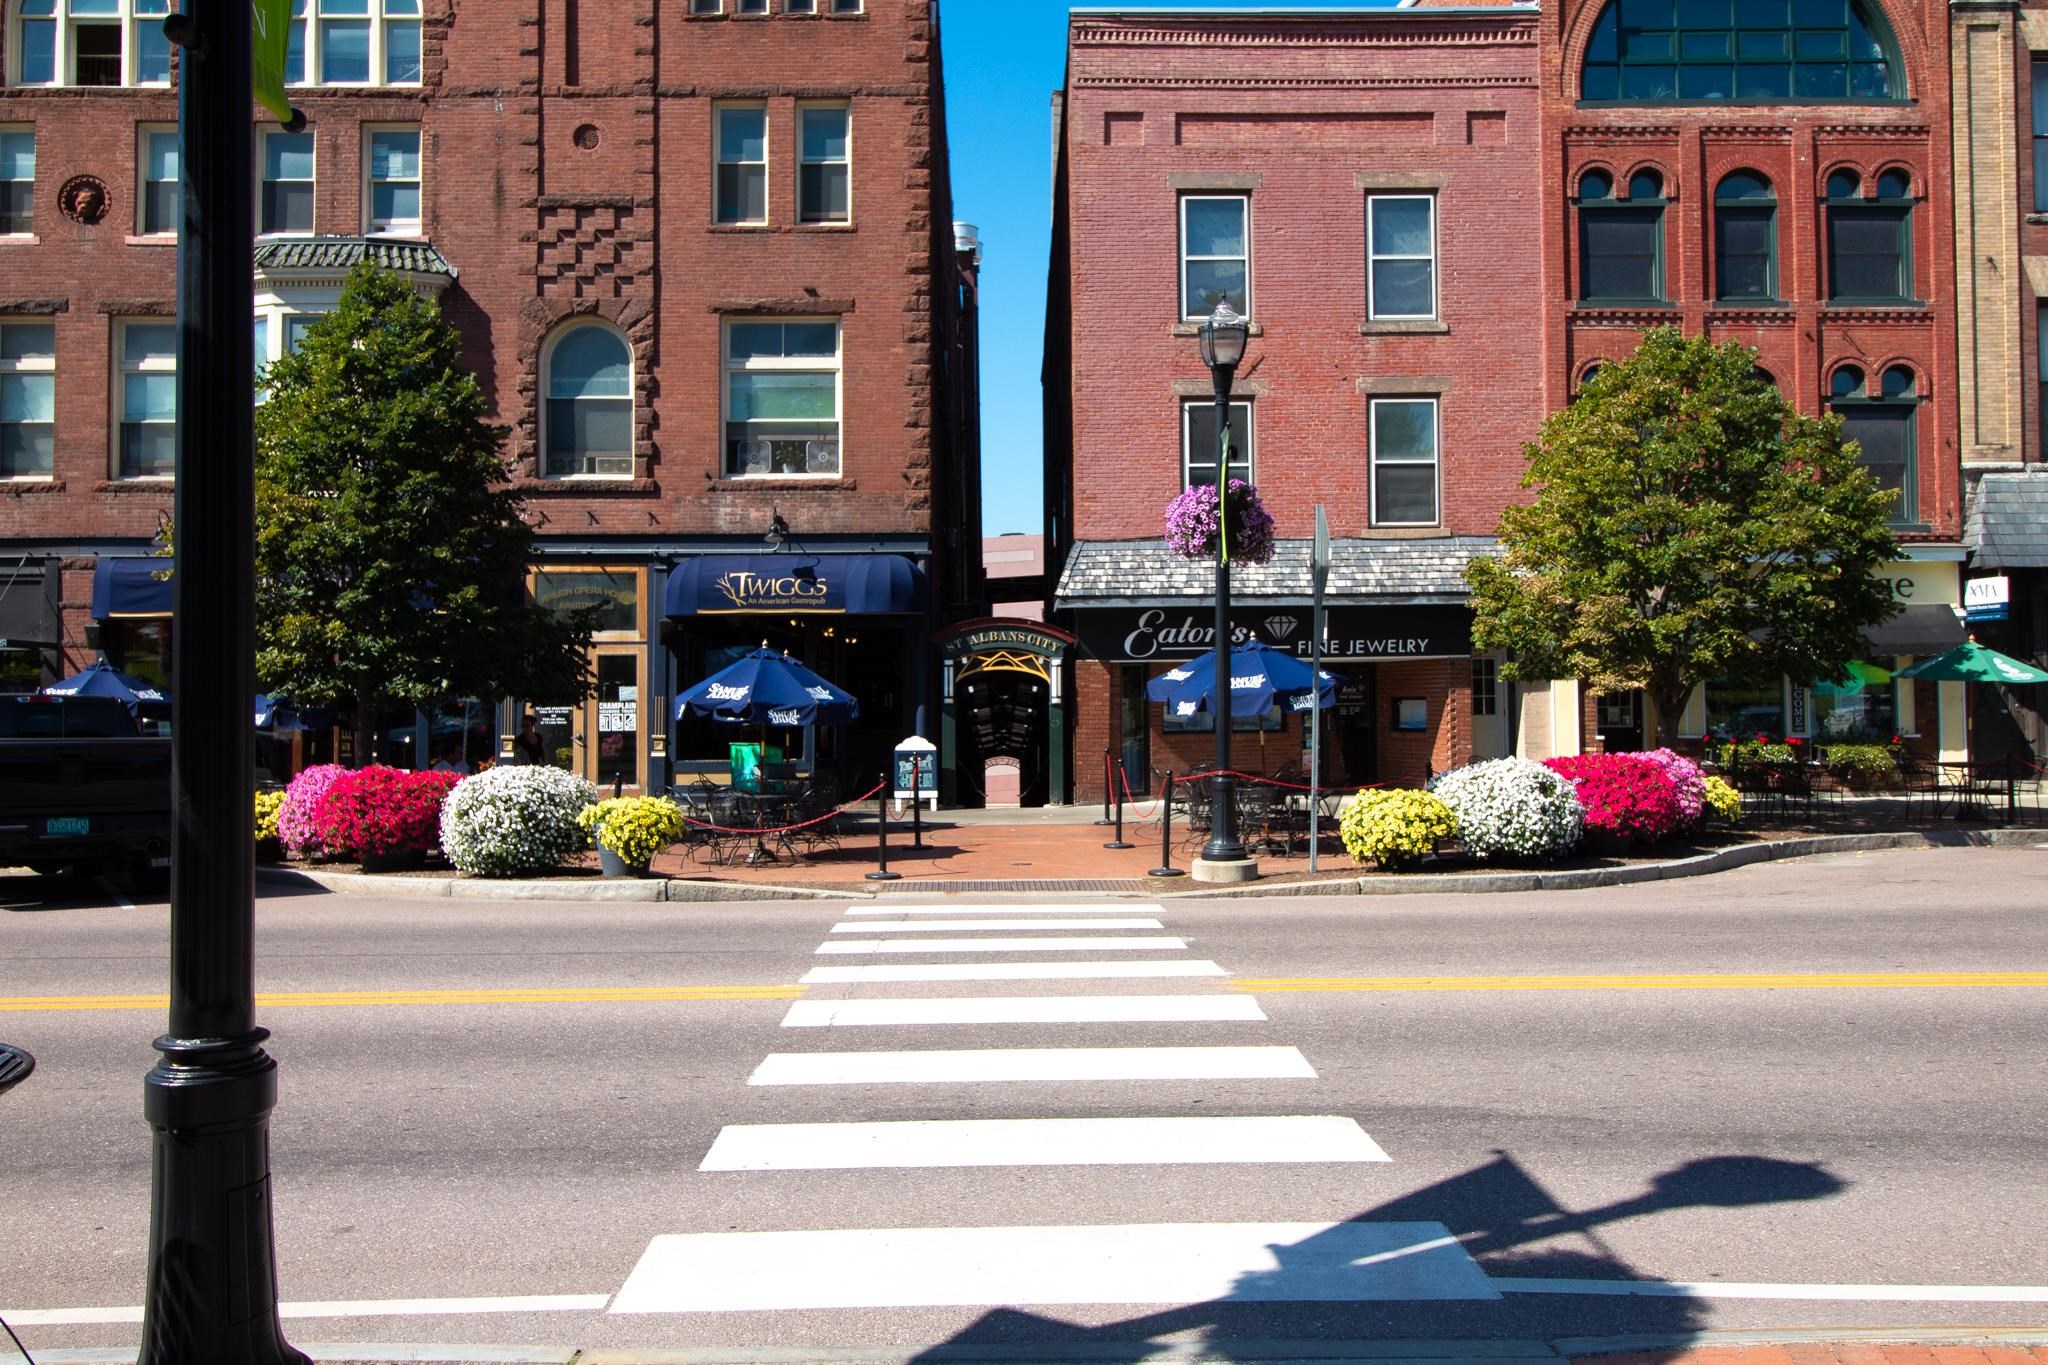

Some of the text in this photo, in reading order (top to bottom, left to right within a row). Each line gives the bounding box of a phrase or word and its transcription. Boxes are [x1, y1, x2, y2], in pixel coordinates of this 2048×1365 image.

[758, 597, 790, 605] American
[969, 631, 1026, 646] ALBANS
[1027, 633, 1061, 652] CITY
[1346, 638, 1429, 655] JEWELRY
[767, 709, 800, 719] SAMUEL
